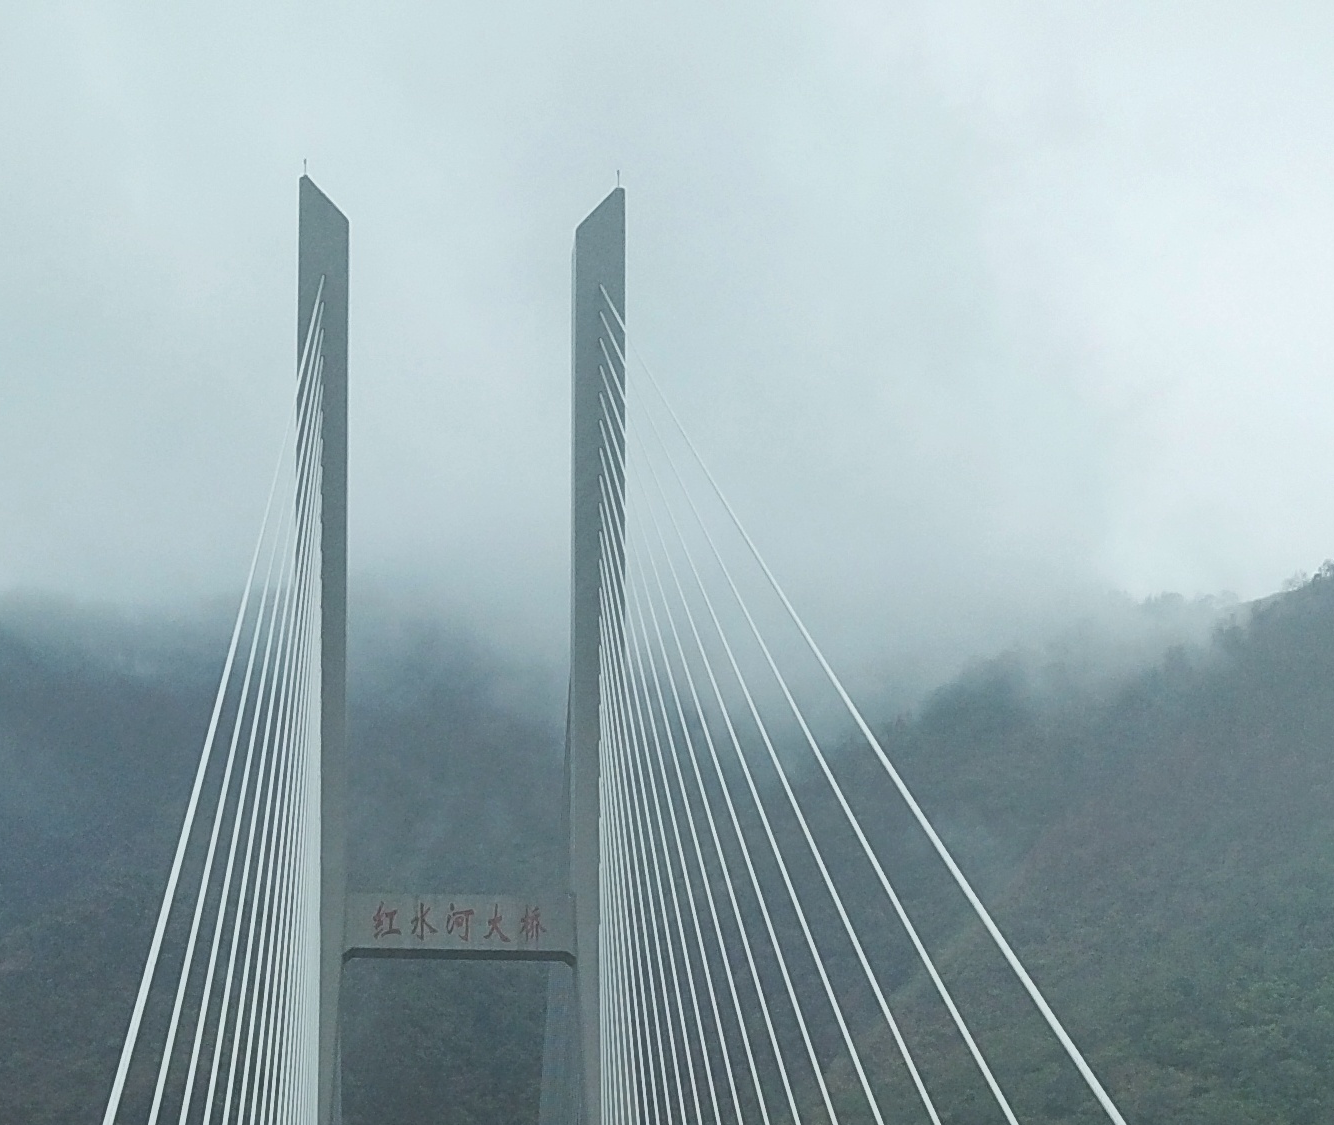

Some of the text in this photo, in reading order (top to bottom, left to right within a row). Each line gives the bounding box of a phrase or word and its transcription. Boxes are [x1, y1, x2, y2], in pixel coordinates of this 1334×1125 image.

[372, 901, 547, 942] 红水河大桥
